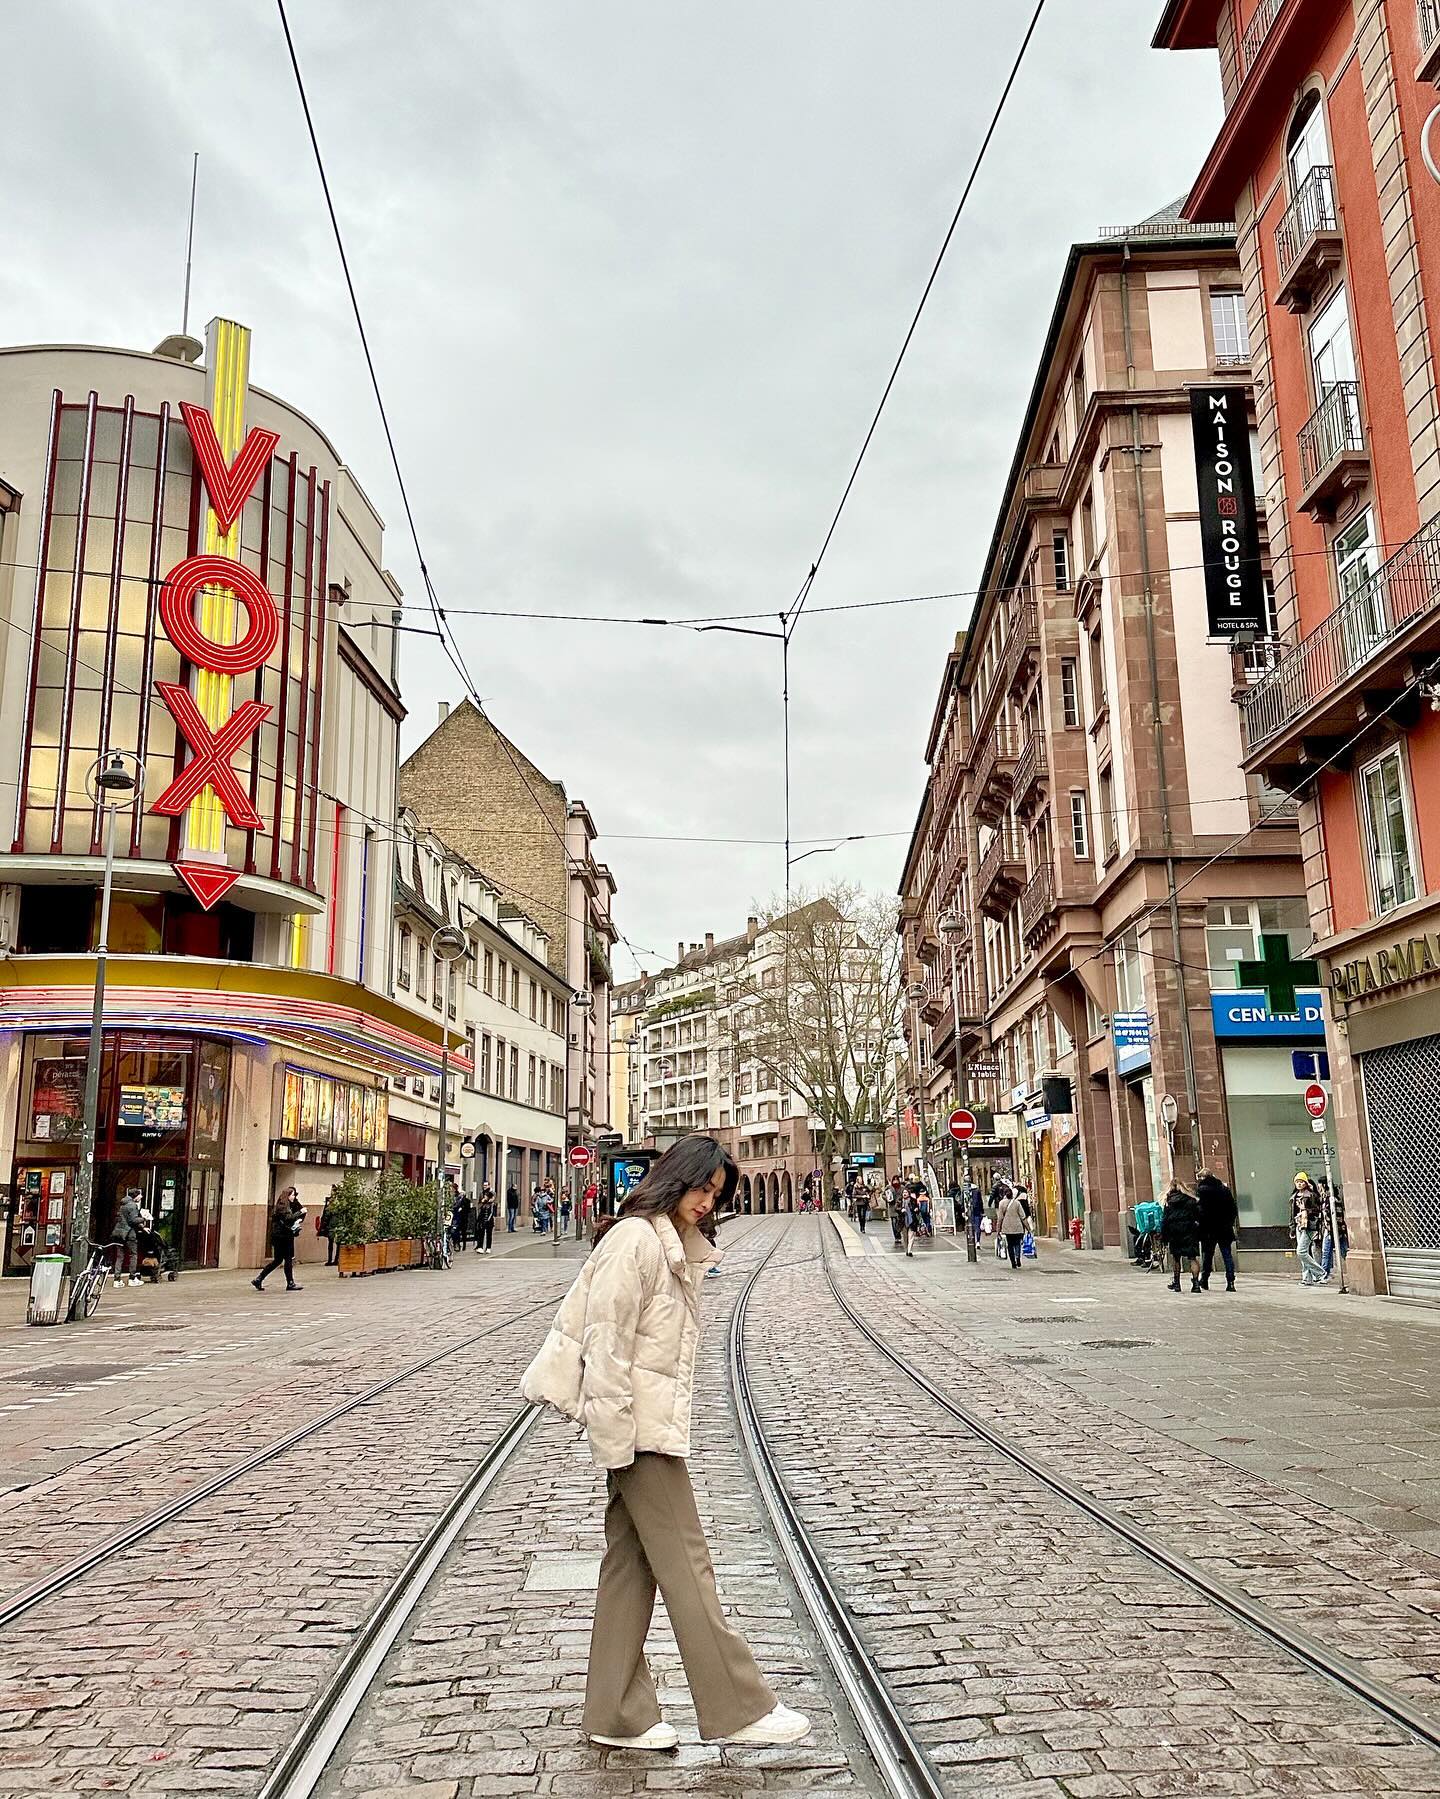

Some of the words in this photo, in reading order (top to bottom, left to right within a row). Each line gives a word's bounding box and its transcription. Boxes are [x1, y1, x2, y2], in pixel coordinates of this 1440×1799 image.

[1209, 395, 1233, 493] MAISON
[1221, 520, 1242, 606] ROUGE
[147, 400, 281, 830] VOX
[1330, 933, 1440, 1000] PHARMA
[968, 1063, 999, 1071] L'Alsace
[1295, 1147, 1336, 1156] DNTYS
